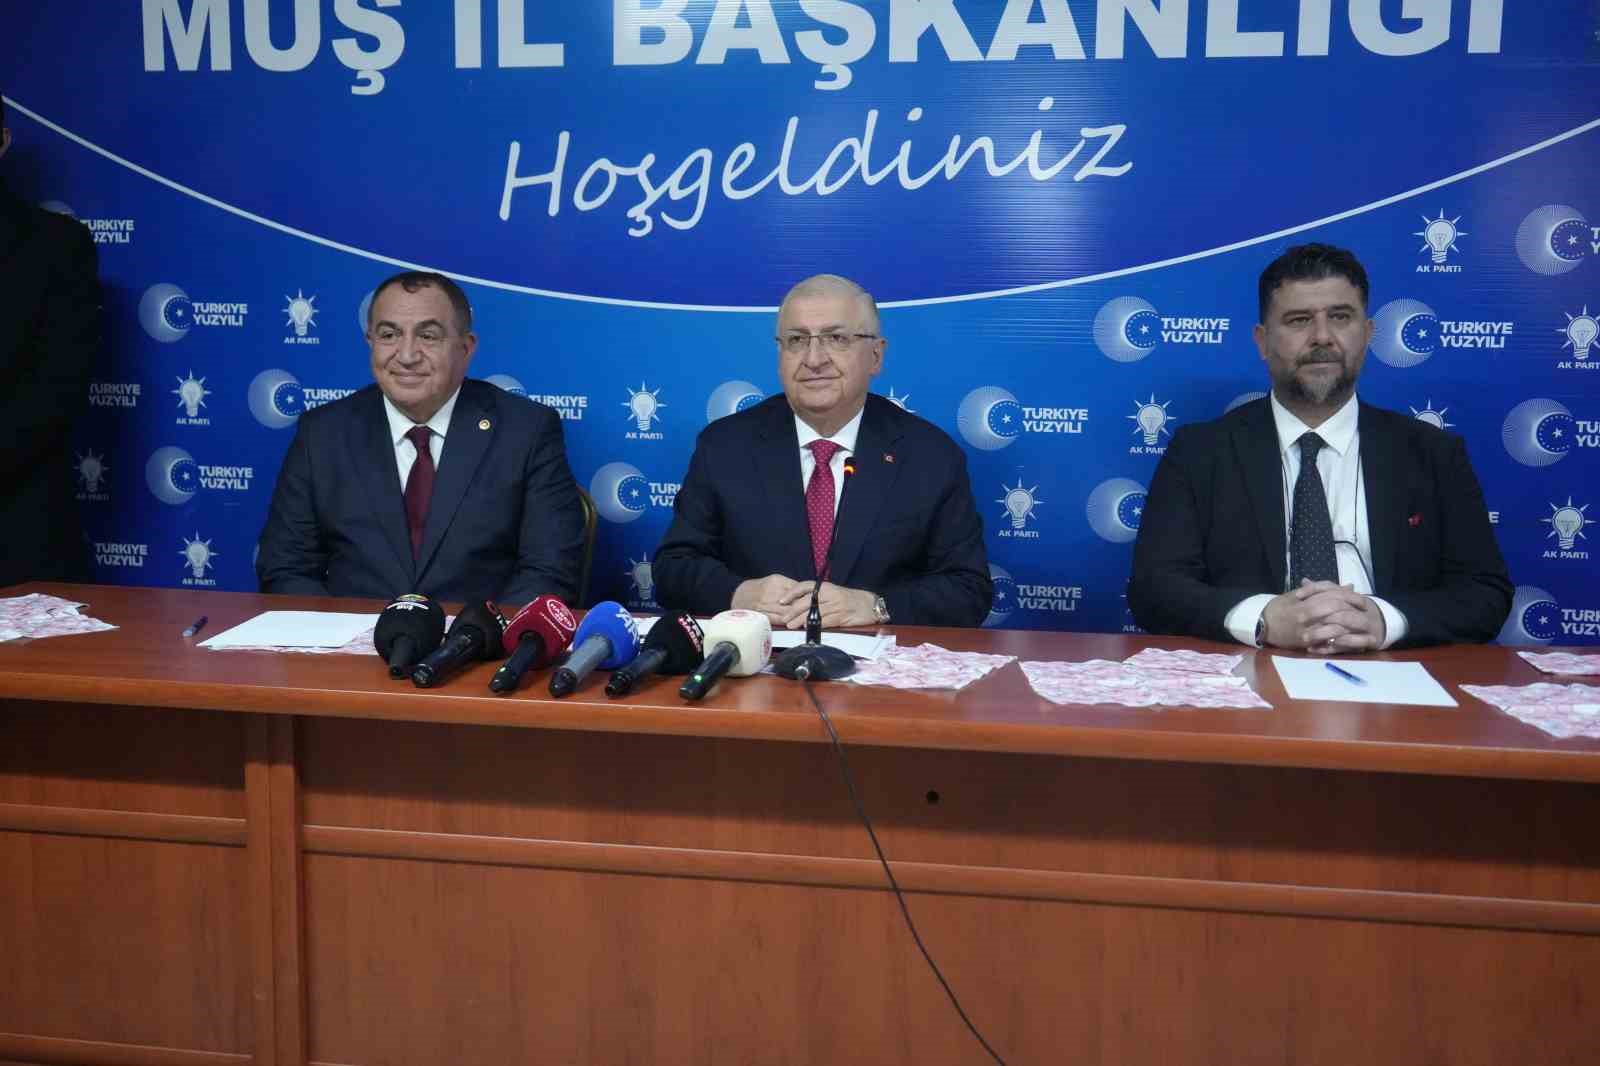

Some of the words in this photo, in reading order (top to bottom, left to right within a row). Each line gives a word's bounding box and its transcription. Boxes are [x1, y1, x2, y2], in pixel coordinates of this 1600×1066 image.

[142, 0, 406, 95] MUŞ
[499, 96, 1133, 238] Hoşgeldiniz
[1416, 265, 1429, 273] AK
[285, 336, 296, 344] AK
[1557, 361, 1572, 370] AK
[1575, 361, 1600, 370] PART
[176, 416, 187, 424] AK
[626, 430, 637, 439] AK
[1130, 446, 1144, 455] AK
[999, 529, 1011, 537] AK
[183, 577, 192, 586] AK
